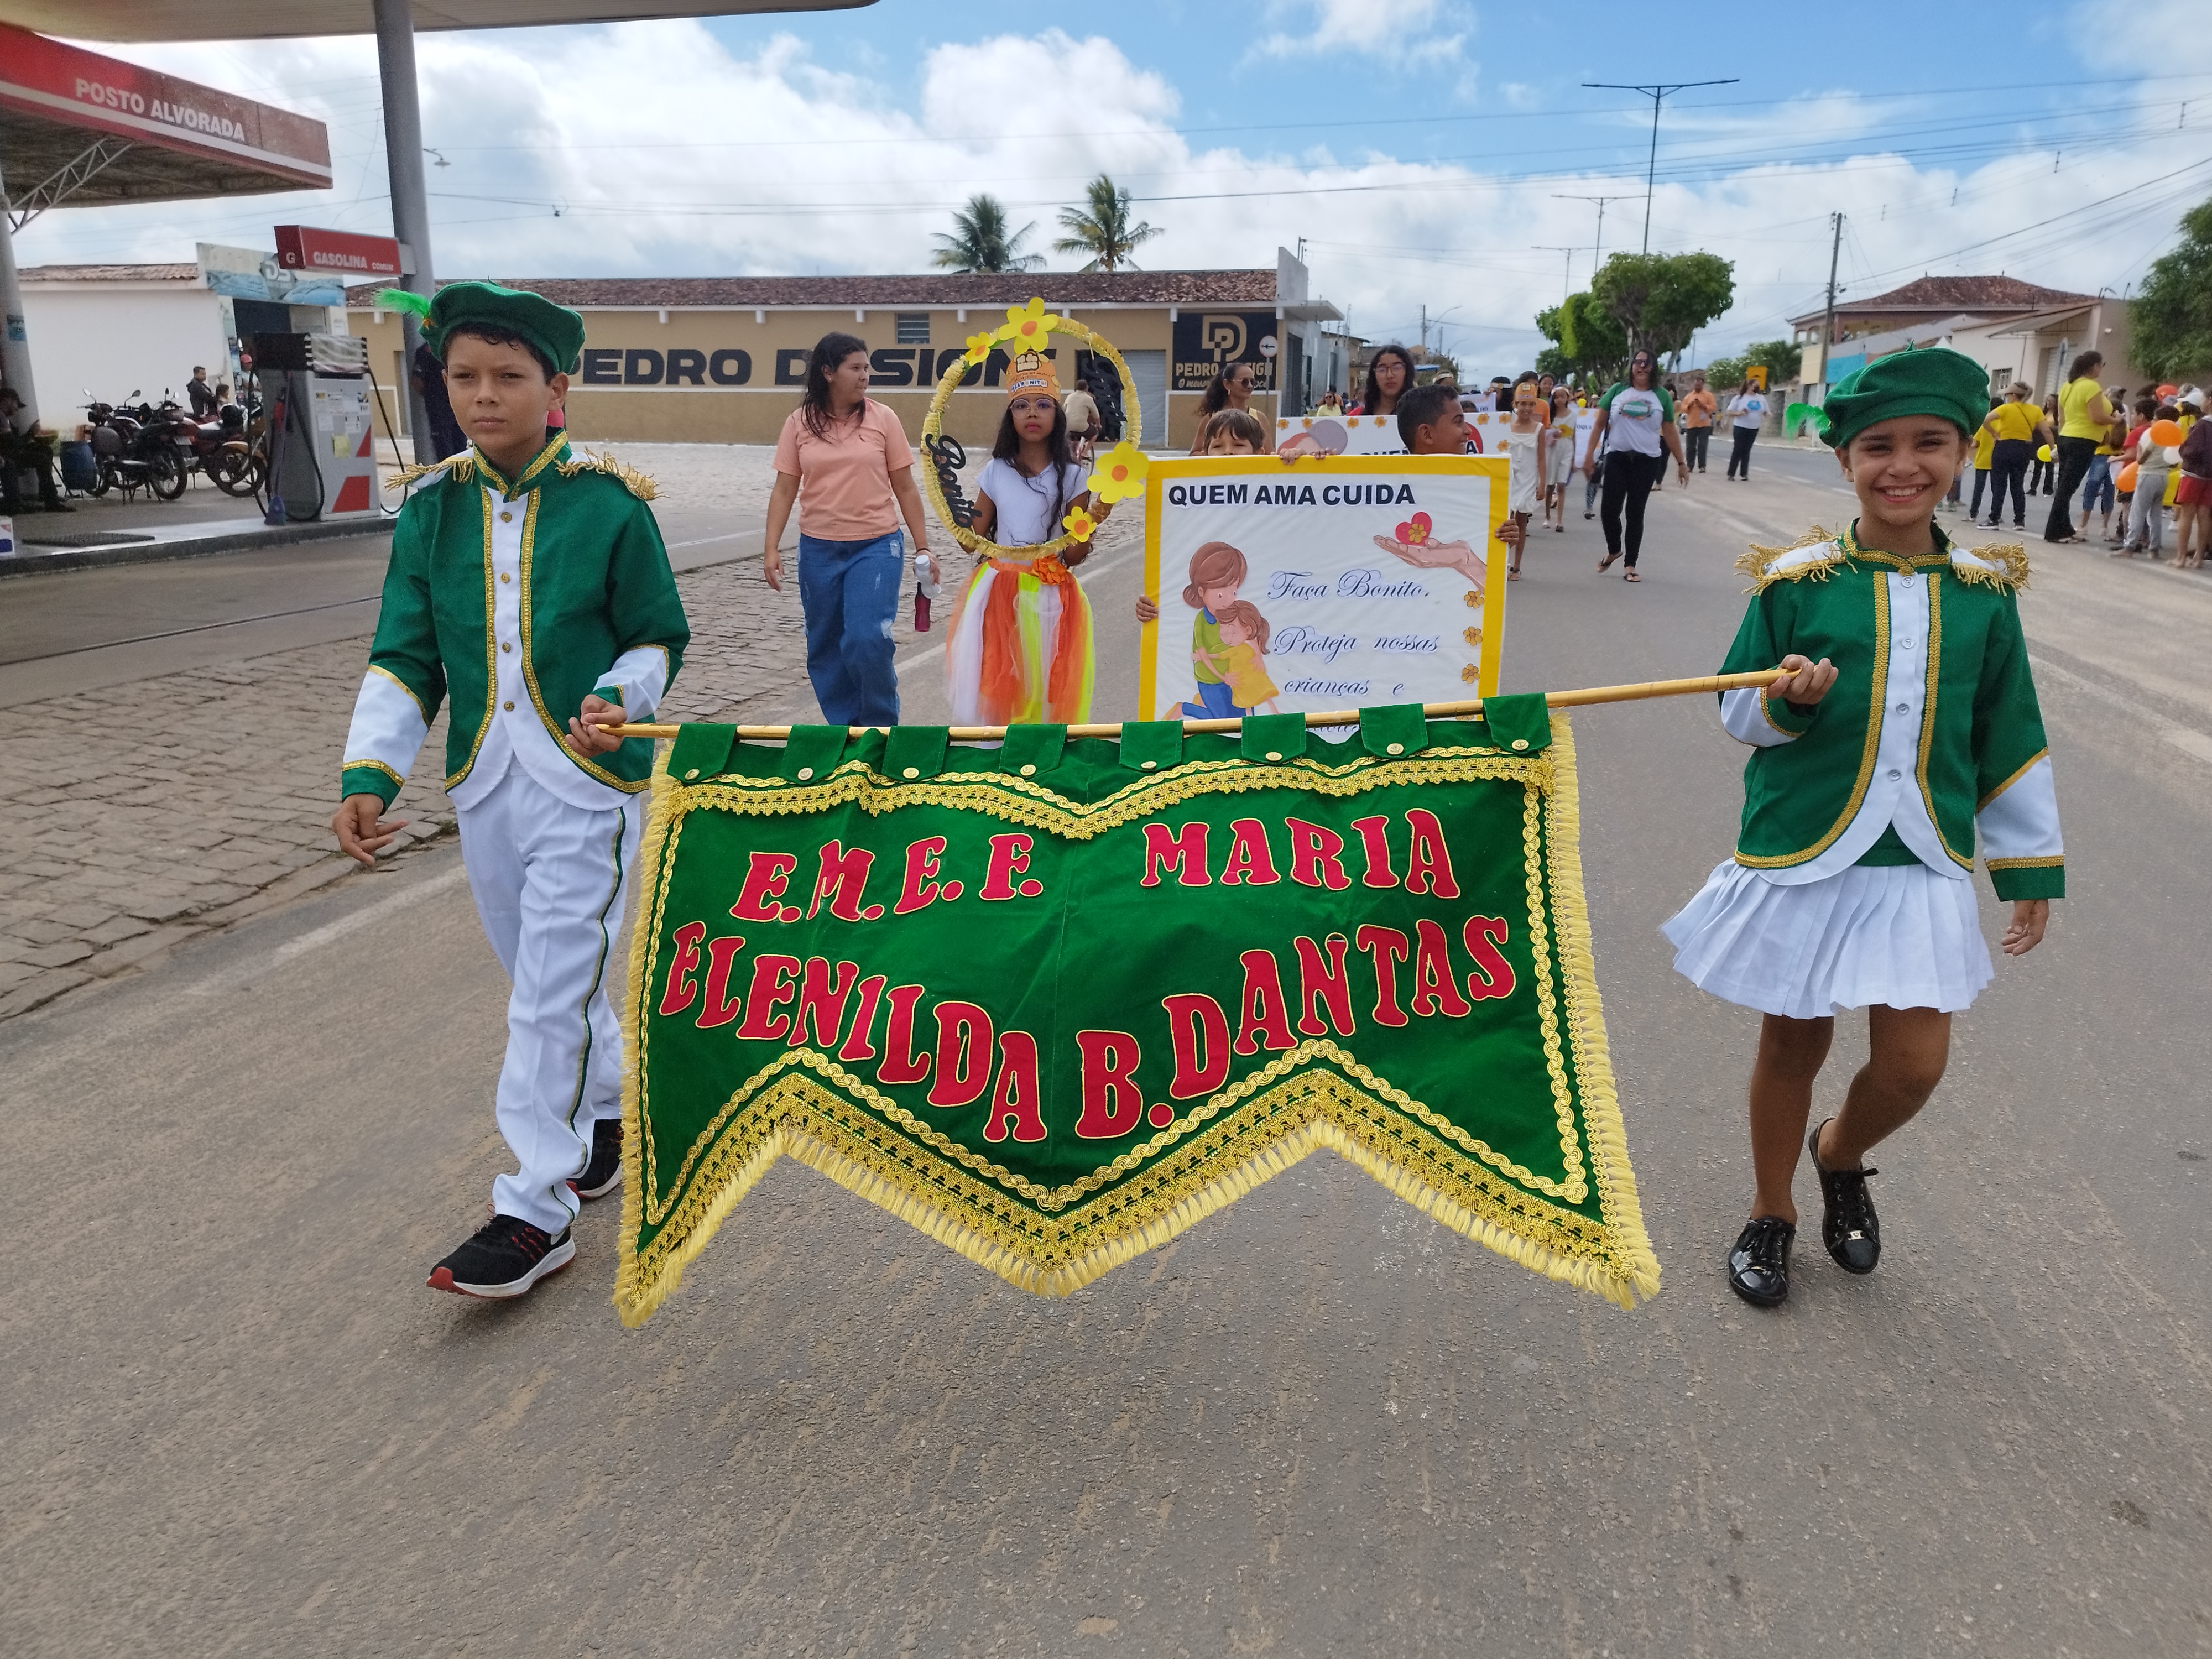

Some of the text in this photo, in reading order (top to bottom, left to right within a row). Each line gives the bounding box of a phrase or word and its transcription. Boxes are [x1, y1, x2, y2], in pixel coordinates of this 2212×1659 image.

[75, 78, 245, 142] POSTO ALVORADA
[286, 252, 296, 264] G
[313, 251, 368, 269] GASOLINA
[568, 349, 752, 385] EDRO
[1176, 363, 1219, 377] PEDRO
[1168, 484, 1416, 507] QUEM AMA CUIDA
[1267, 568, 1430, 600] Faça Bonito.
[1274, 625, 1440, 664] Proteja nossas
[1284, 677, 1404, 697] crianças e
[1140, 808, 1460, 899] MARIA
[659, 920, 1047, 1142] ELENILDA
[1161, 914, 1516, 1100] DANTAS
